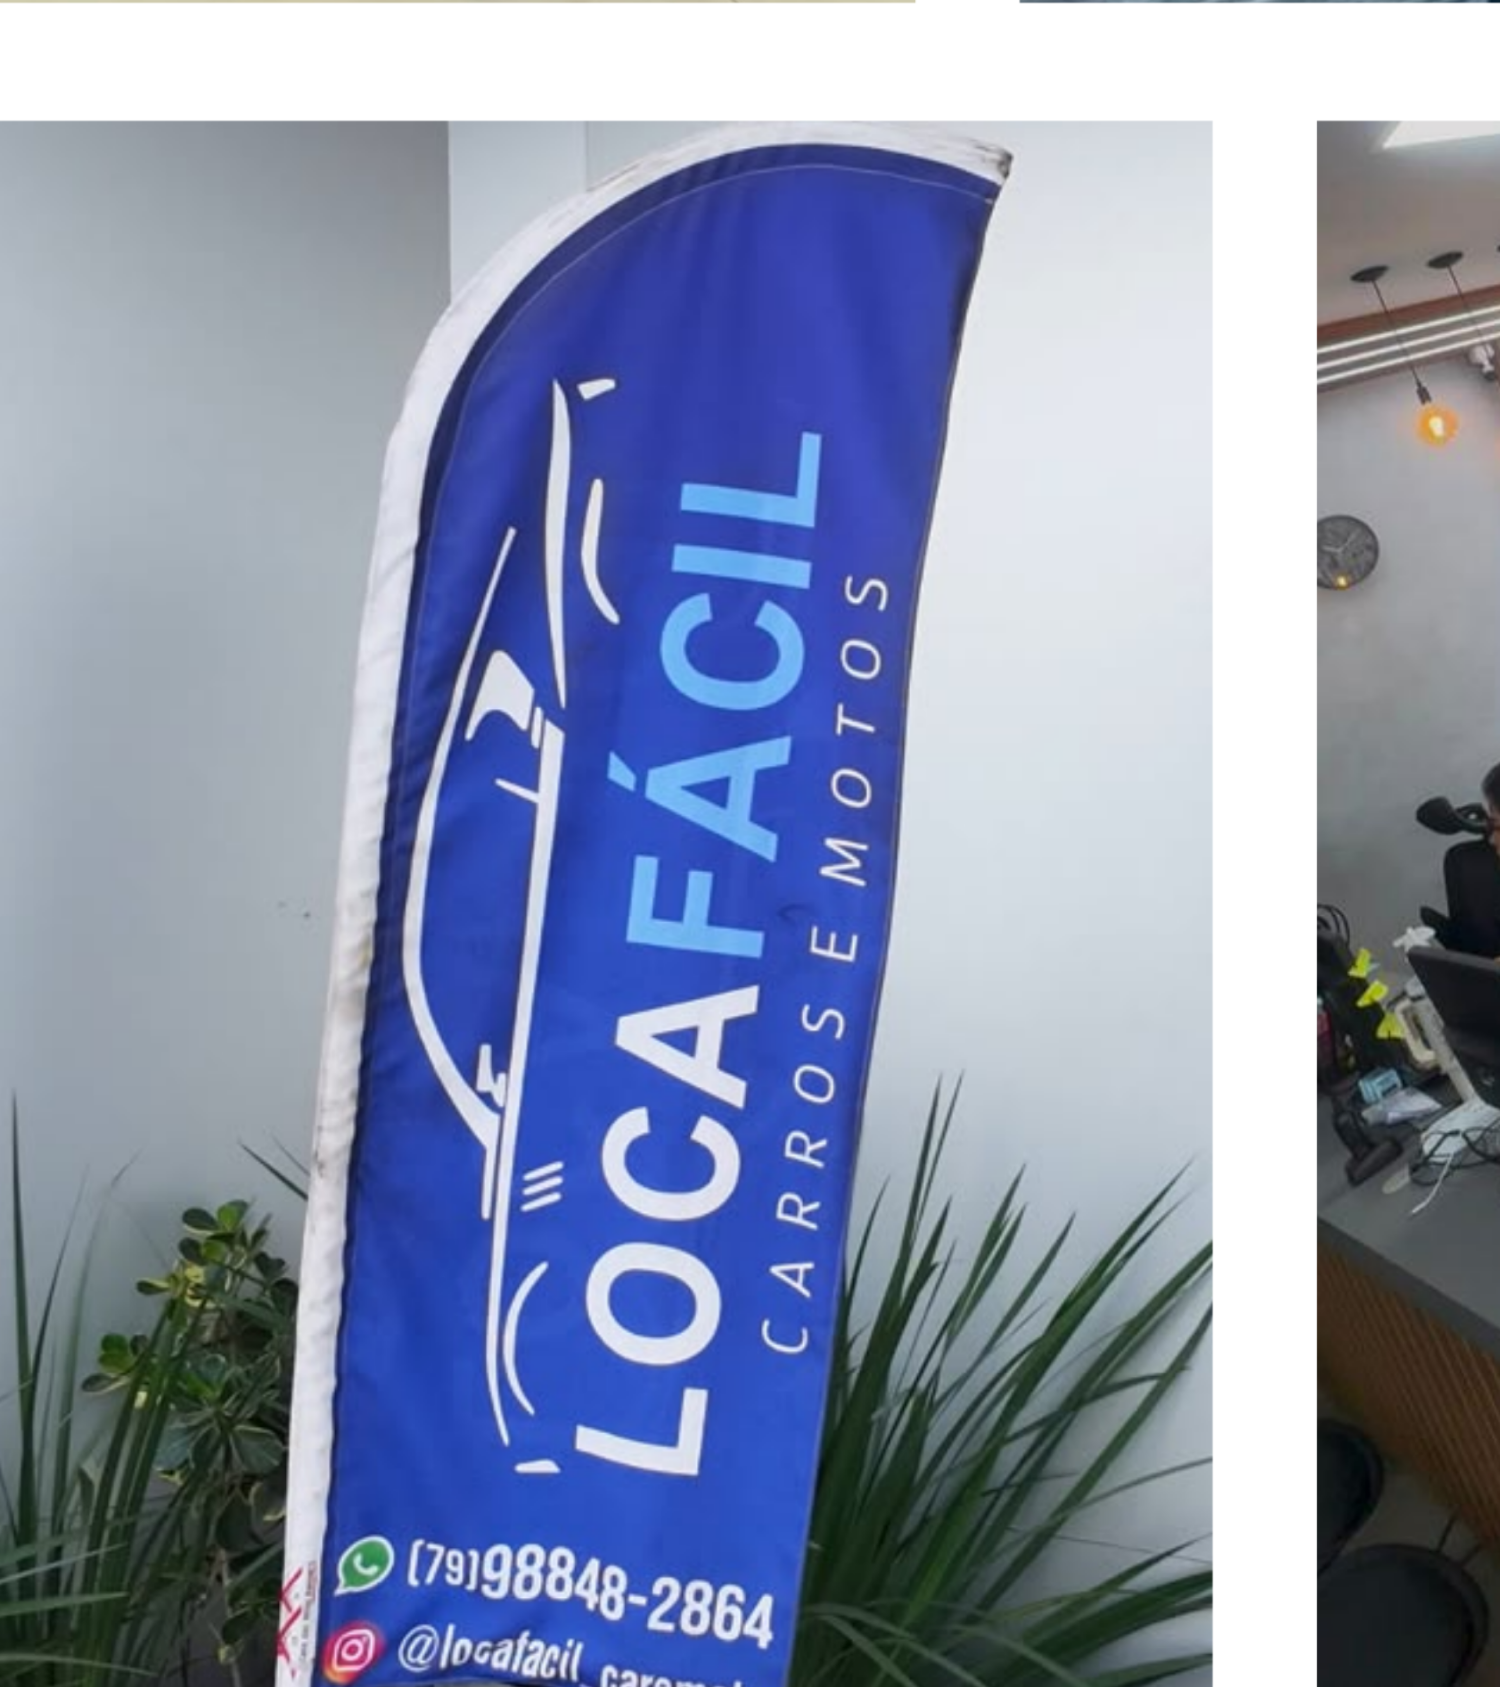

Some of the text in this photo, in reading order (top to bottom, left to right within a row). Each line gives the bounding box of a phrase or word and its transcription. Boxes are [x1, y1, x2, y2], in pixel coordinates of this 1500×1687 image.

[574, 431, 823, 1477] LOCAFÁCIL
[762, 573, 890, 1355] CARROS E MOTOS
